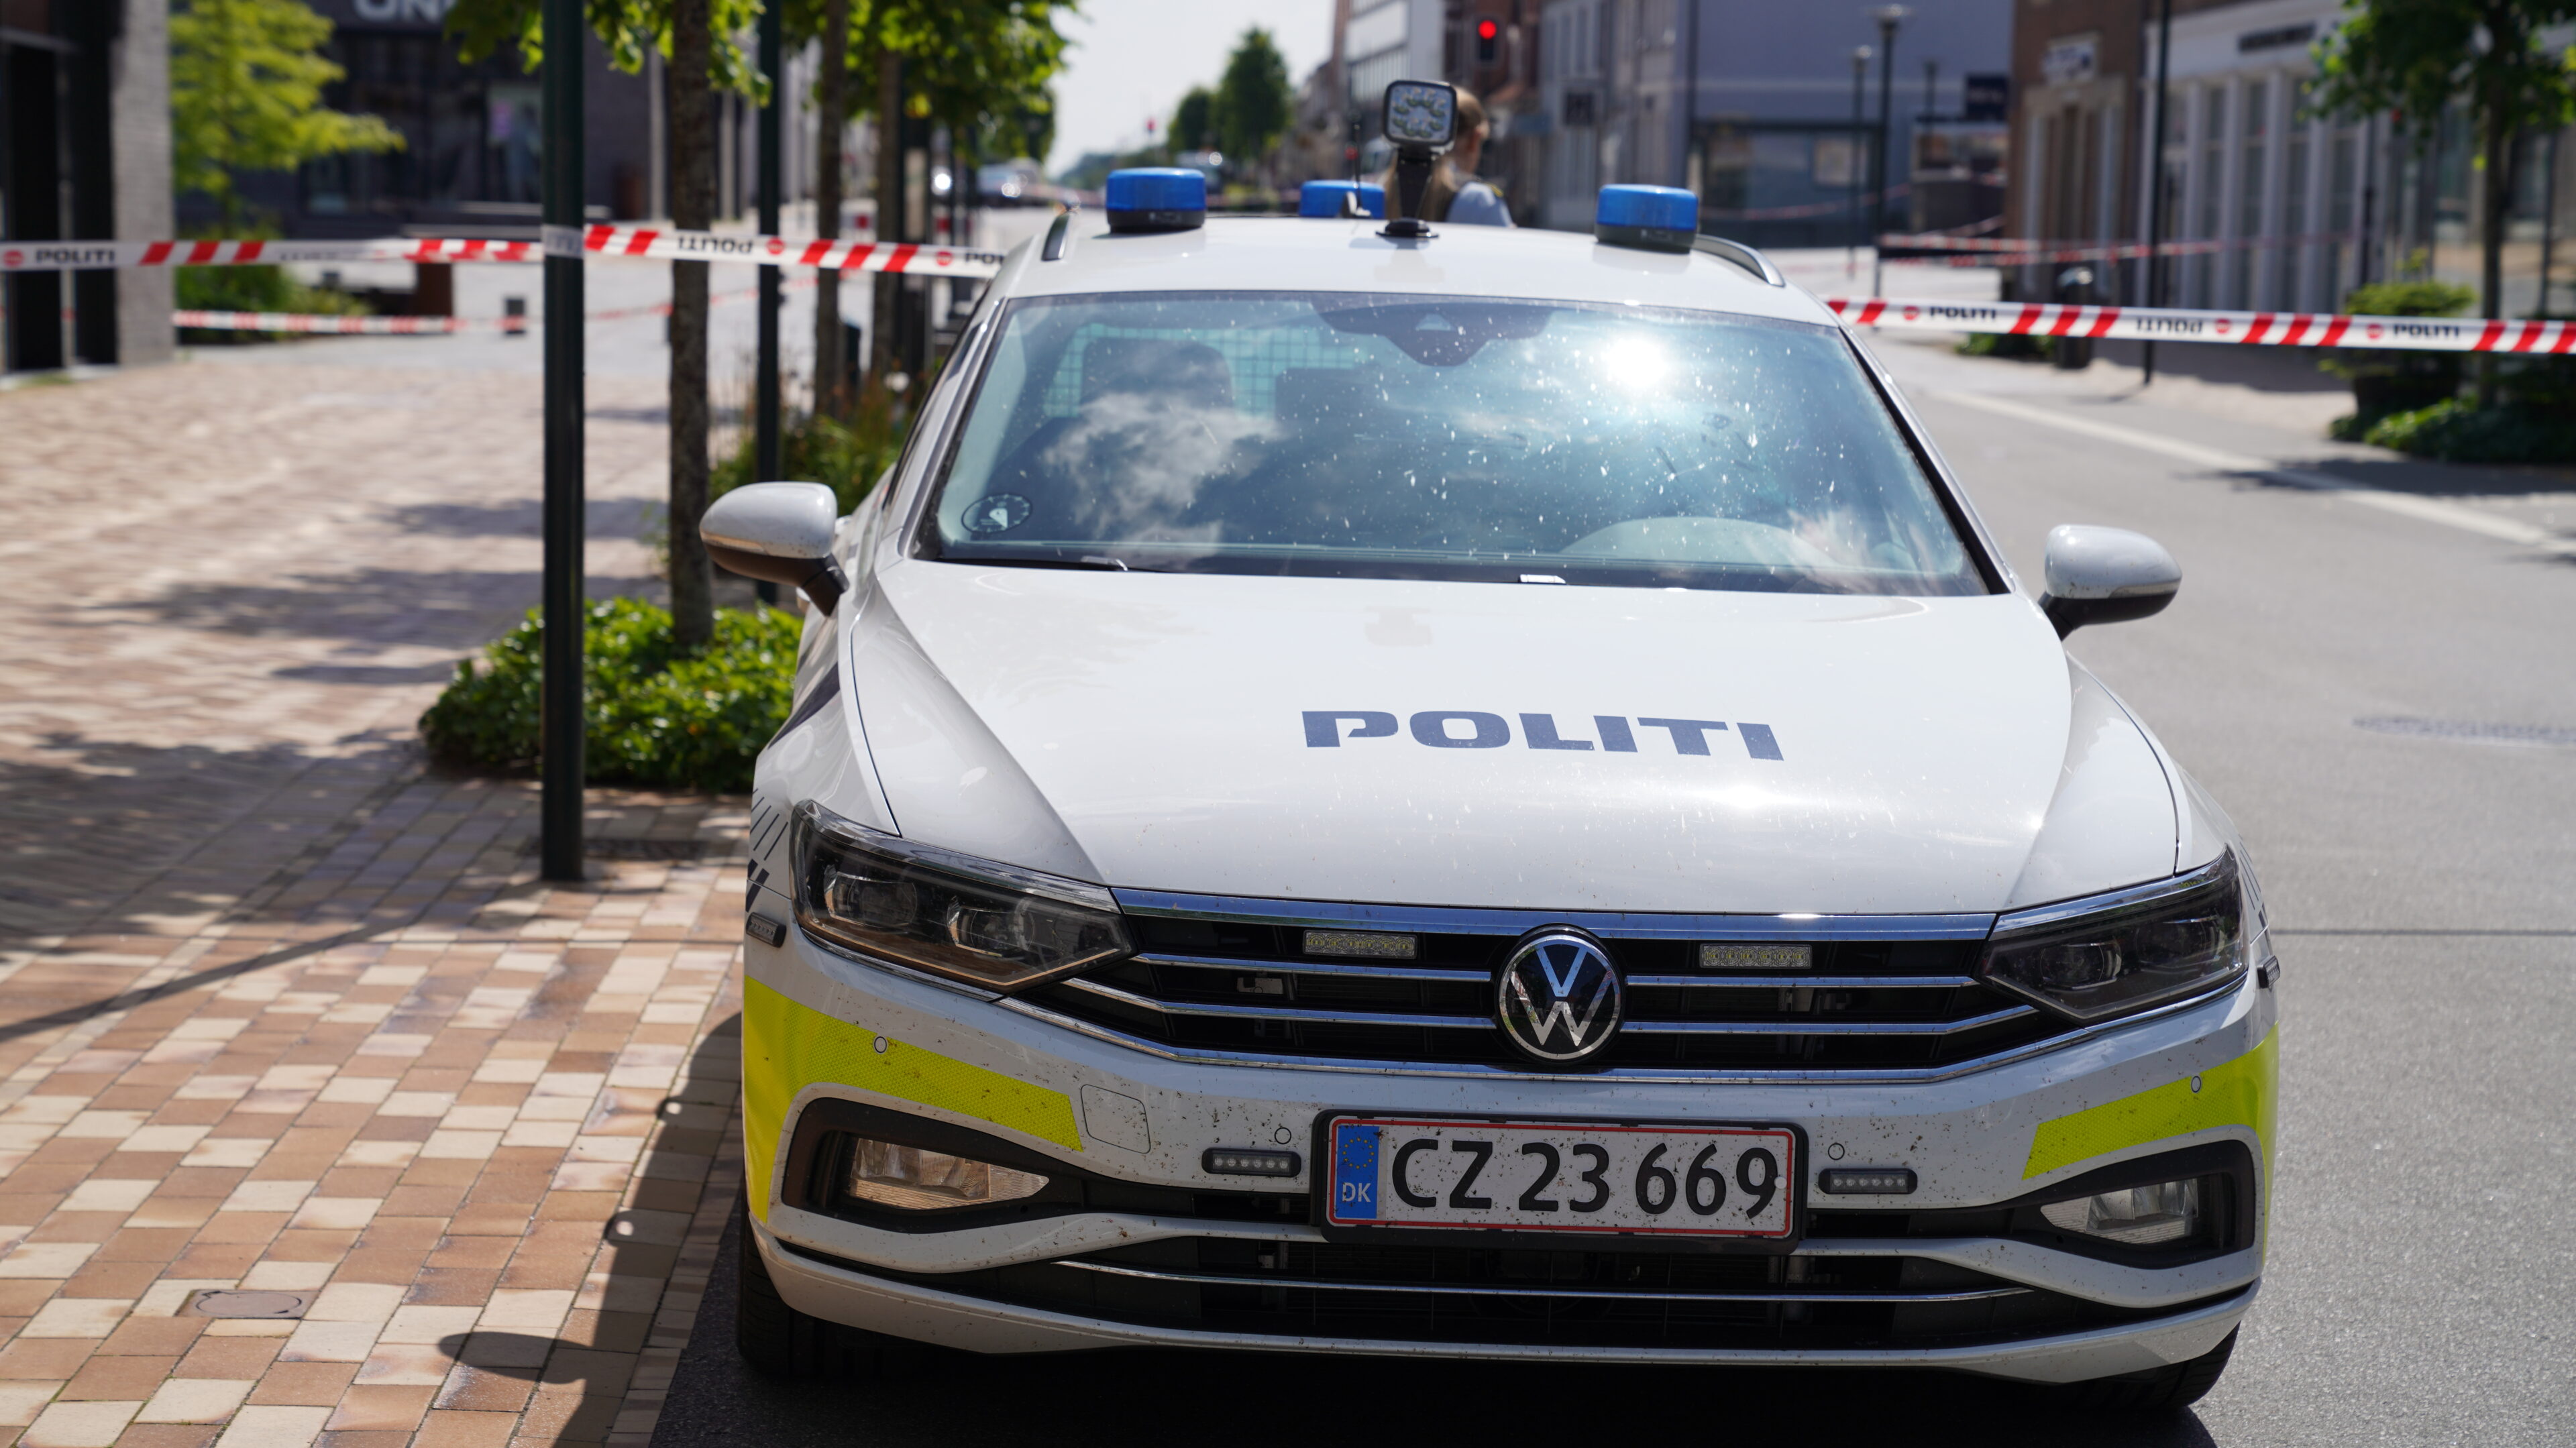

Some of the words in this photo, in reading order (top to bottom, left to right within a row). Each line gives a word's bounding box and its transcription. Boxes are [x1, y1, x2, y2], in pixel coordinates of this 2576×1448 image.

[678, 236, 754, 254] POLITI
[36, 247, 116, 264] POLITI
[1929, 305, 1997, 320] POLITI
[2136, 317, 2203, 333] POLITI
[2393, 323, 2461, 339] POLITI
[1301, 710, 1784, 761] POLITI
[1391, 1138, 1493, 1210] CZ
[1518, 1141, 1610, 1213] 23
[1635, 1141, 1780, 1220] 669
[1342, 1181, 1372, 1203] DK
